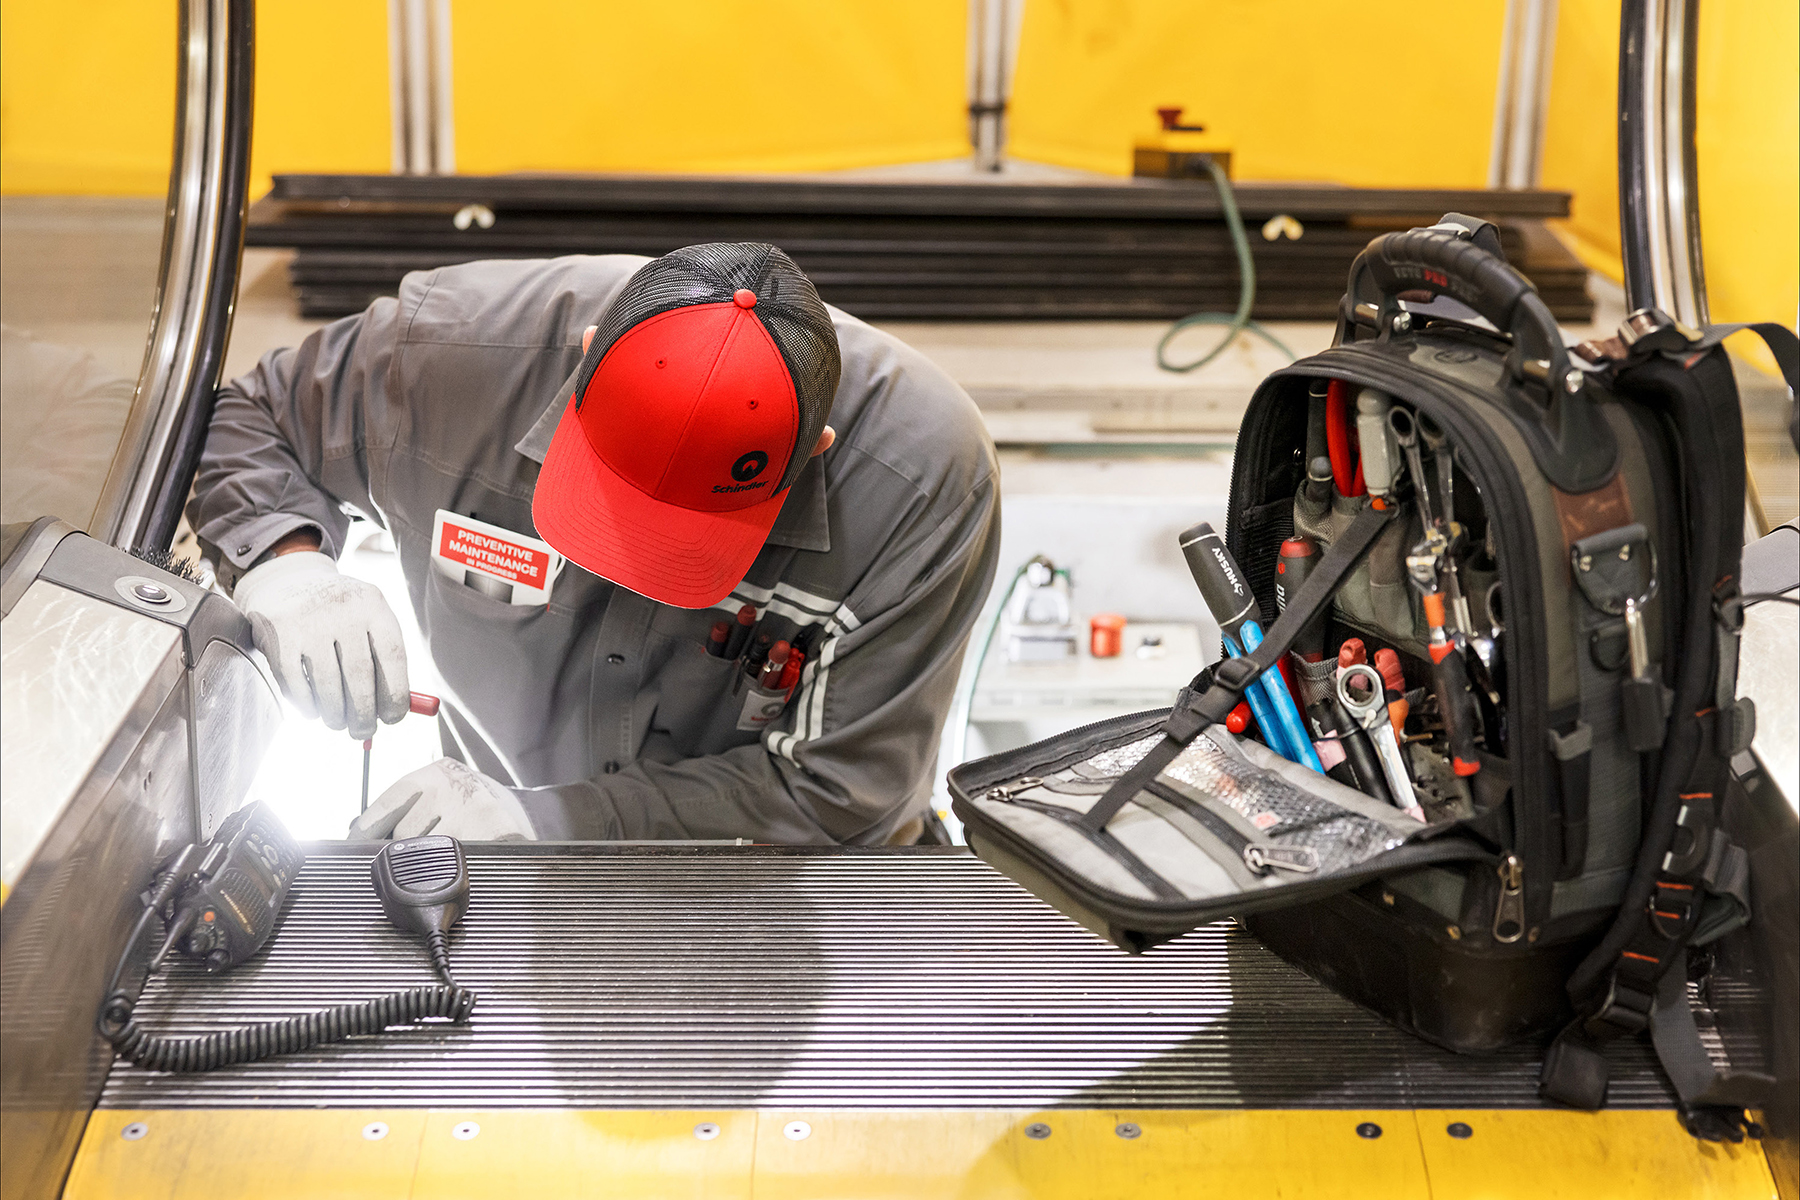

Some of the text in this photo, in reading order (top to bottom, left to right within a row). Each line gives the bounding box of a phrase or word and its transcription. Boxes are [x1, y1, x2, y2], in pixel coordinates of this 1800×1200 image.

[711, 480, 769, 493] Schindler
[449, 540, 539, 577] MAINTENANCE
[457, 530, 534, 562] PREVENTIVE
[466, 558, 517, 580] IN PROGRESS
[1211, 547, 1238, 585] HUSKY
